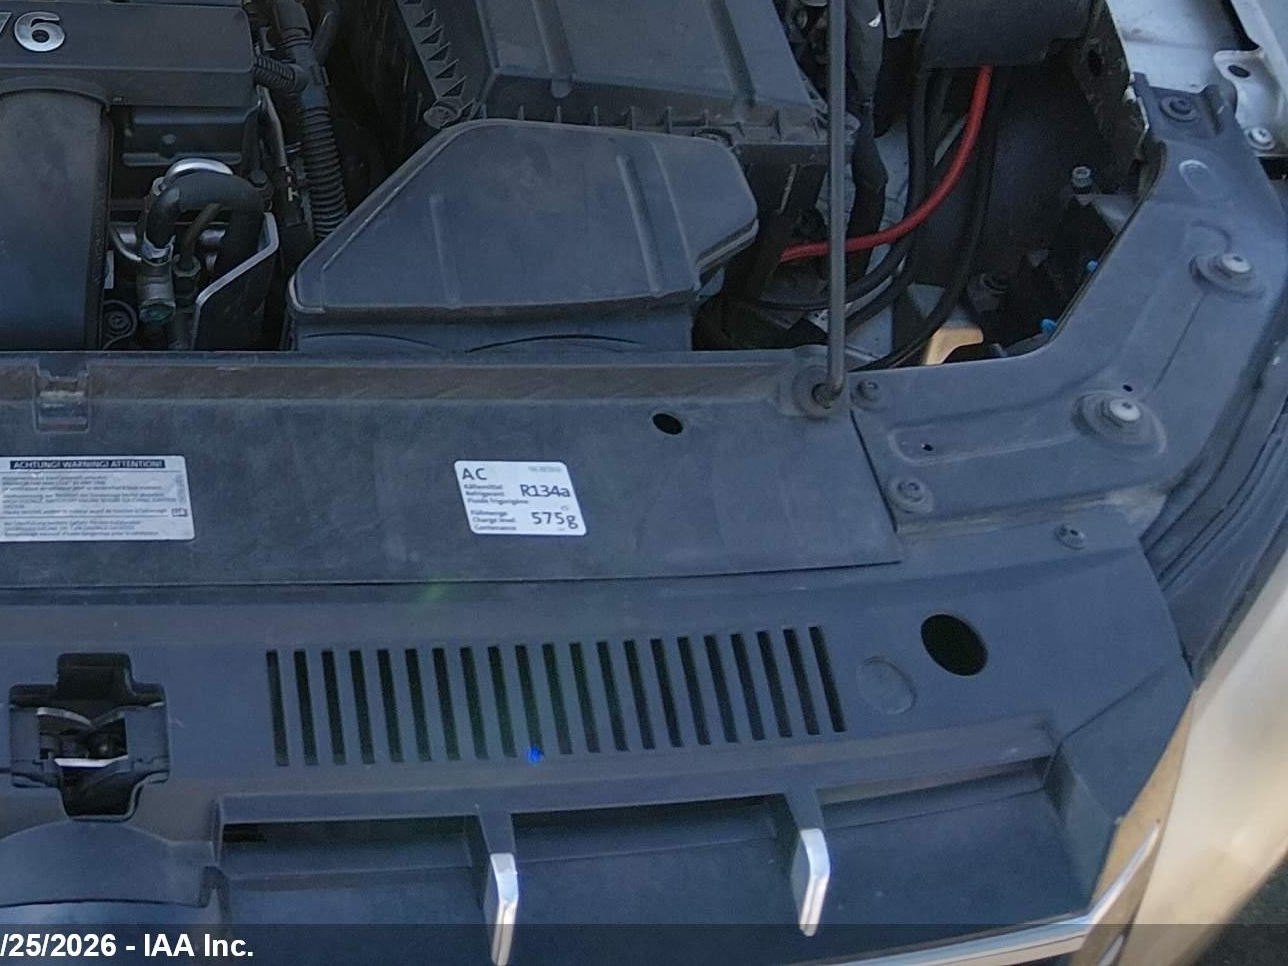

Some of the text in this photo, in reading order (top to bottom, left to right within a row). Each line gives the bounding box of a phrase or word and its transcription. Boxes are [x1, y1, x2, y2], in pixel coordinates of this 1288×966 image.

[13, 459, 163, 469] ACHTUNG! WARNING! ATTENTION!
[462, 467, 488, 480] AC
[520, 484, 571, 498] R134a
